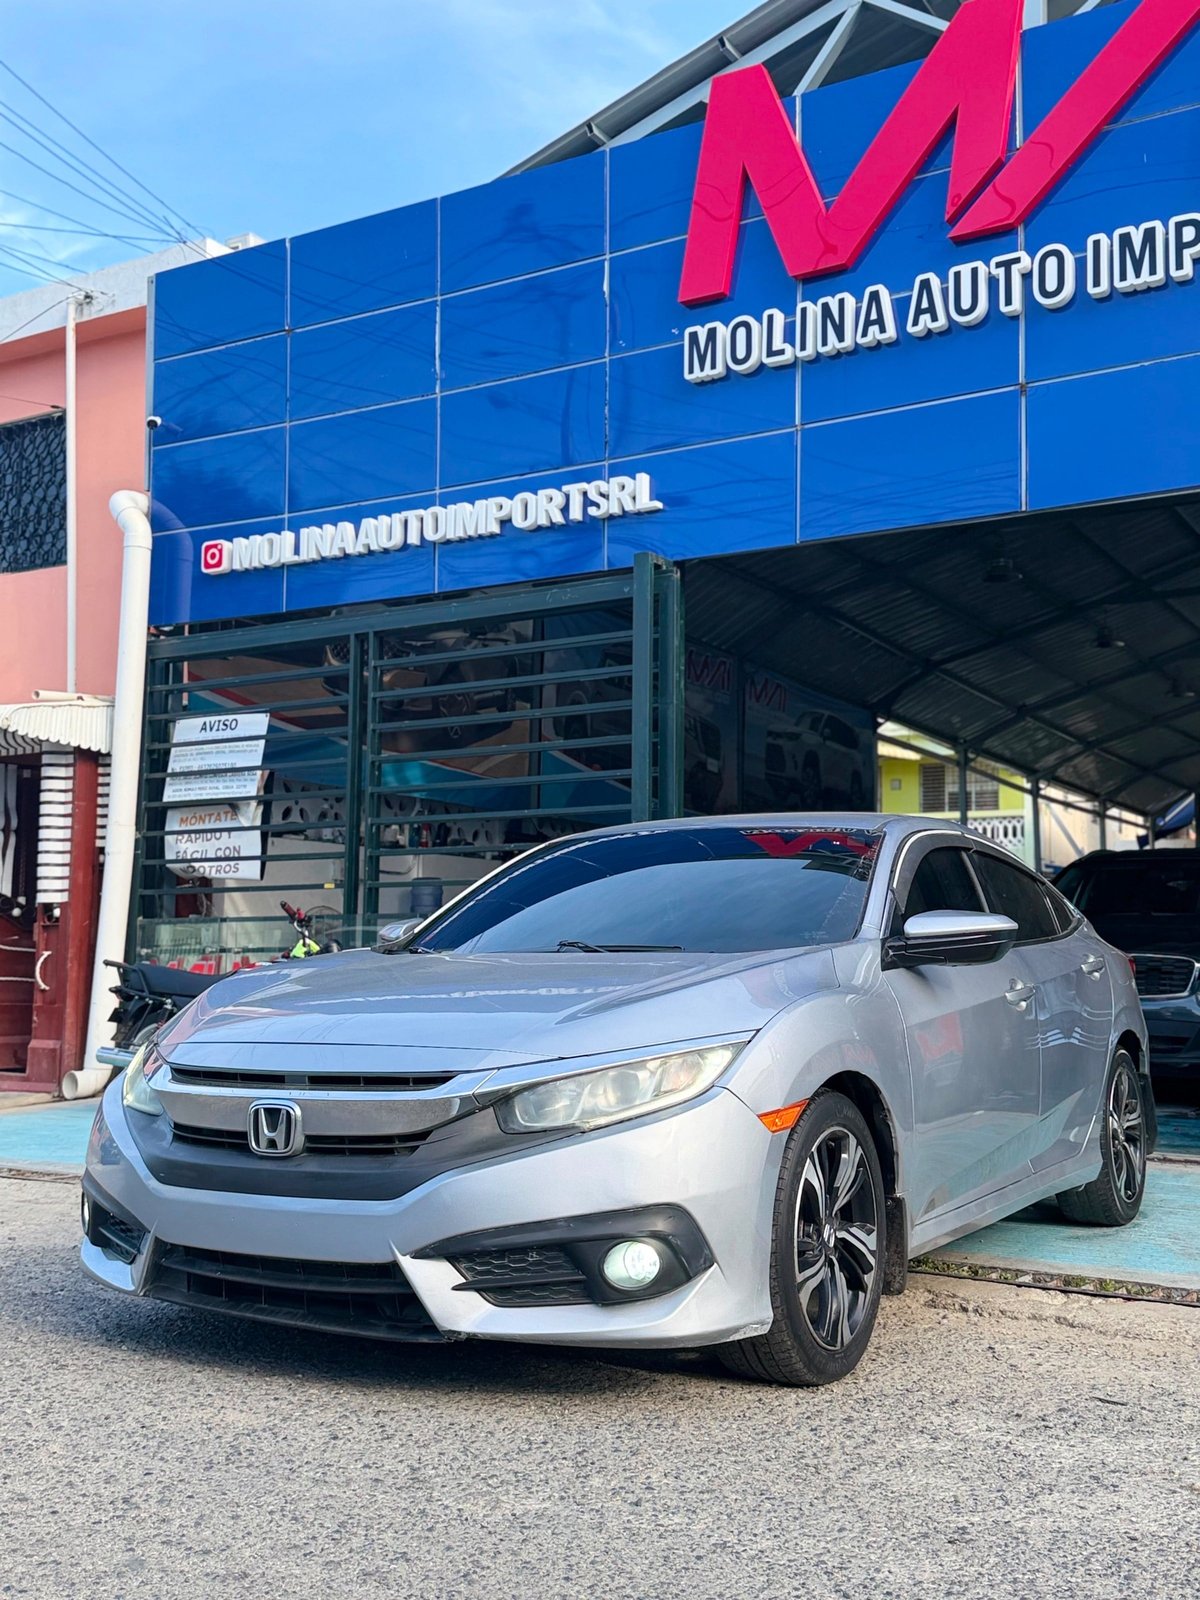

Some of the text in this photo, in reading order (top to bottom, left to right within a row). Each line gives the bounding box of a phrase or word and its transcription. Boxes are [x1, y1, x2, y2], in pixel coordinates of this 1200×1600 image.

[682, 283, 897, 384] MOLINA
[906, 242, 1075, 338] AUTO
[231, 472, 665, 571] MOLINAAUTOIMPORTSRL
[199, 718, 239, 734] AVISO
[214, 844, 242, 858] CON
